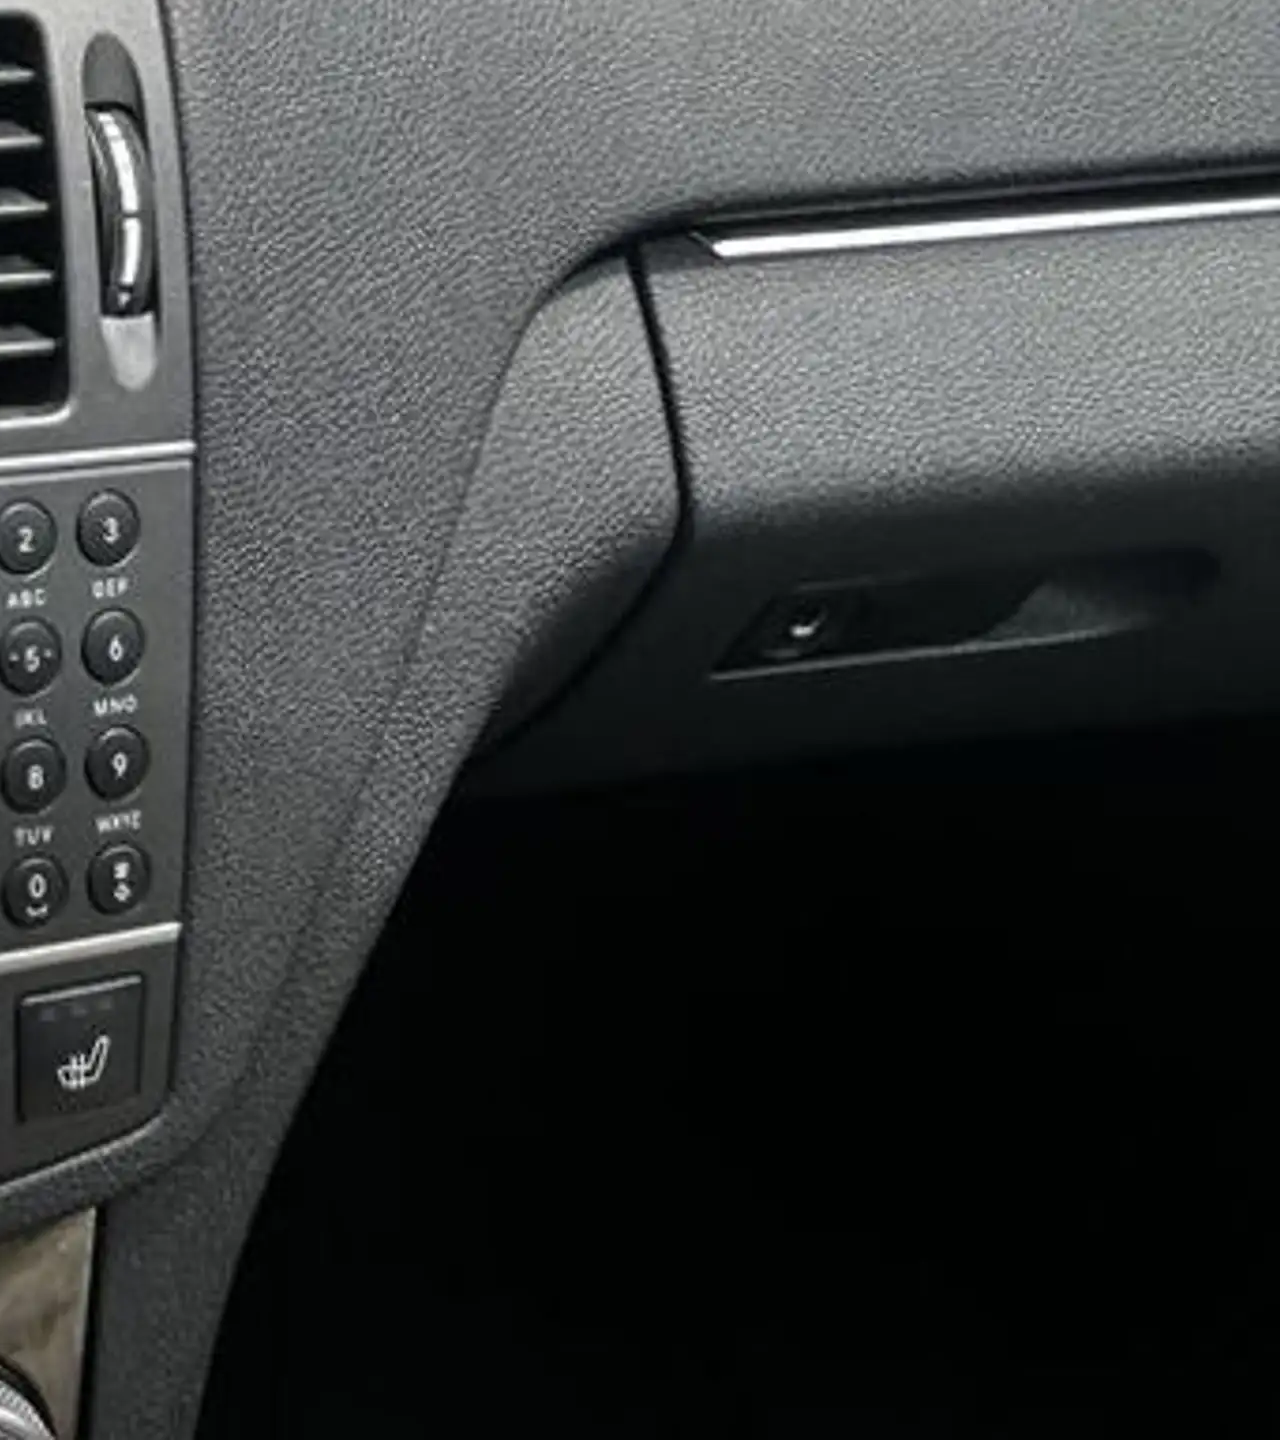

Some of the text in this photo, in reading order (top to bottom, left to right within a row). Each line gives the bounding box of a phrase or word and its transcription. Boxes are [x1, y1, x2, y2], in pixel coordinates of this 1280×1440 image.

[17, 528, 36, 553] 2
[102, 517, 120, 543] 3
[6, 588, 48, 610] ABC
[23, 644, 42, 673] 5
[108, 636, 124, 663] 6
[26, 764, 45, 791] 8
[111, 751, 129, 780] 9
[28, 872, 48, 900] 0
